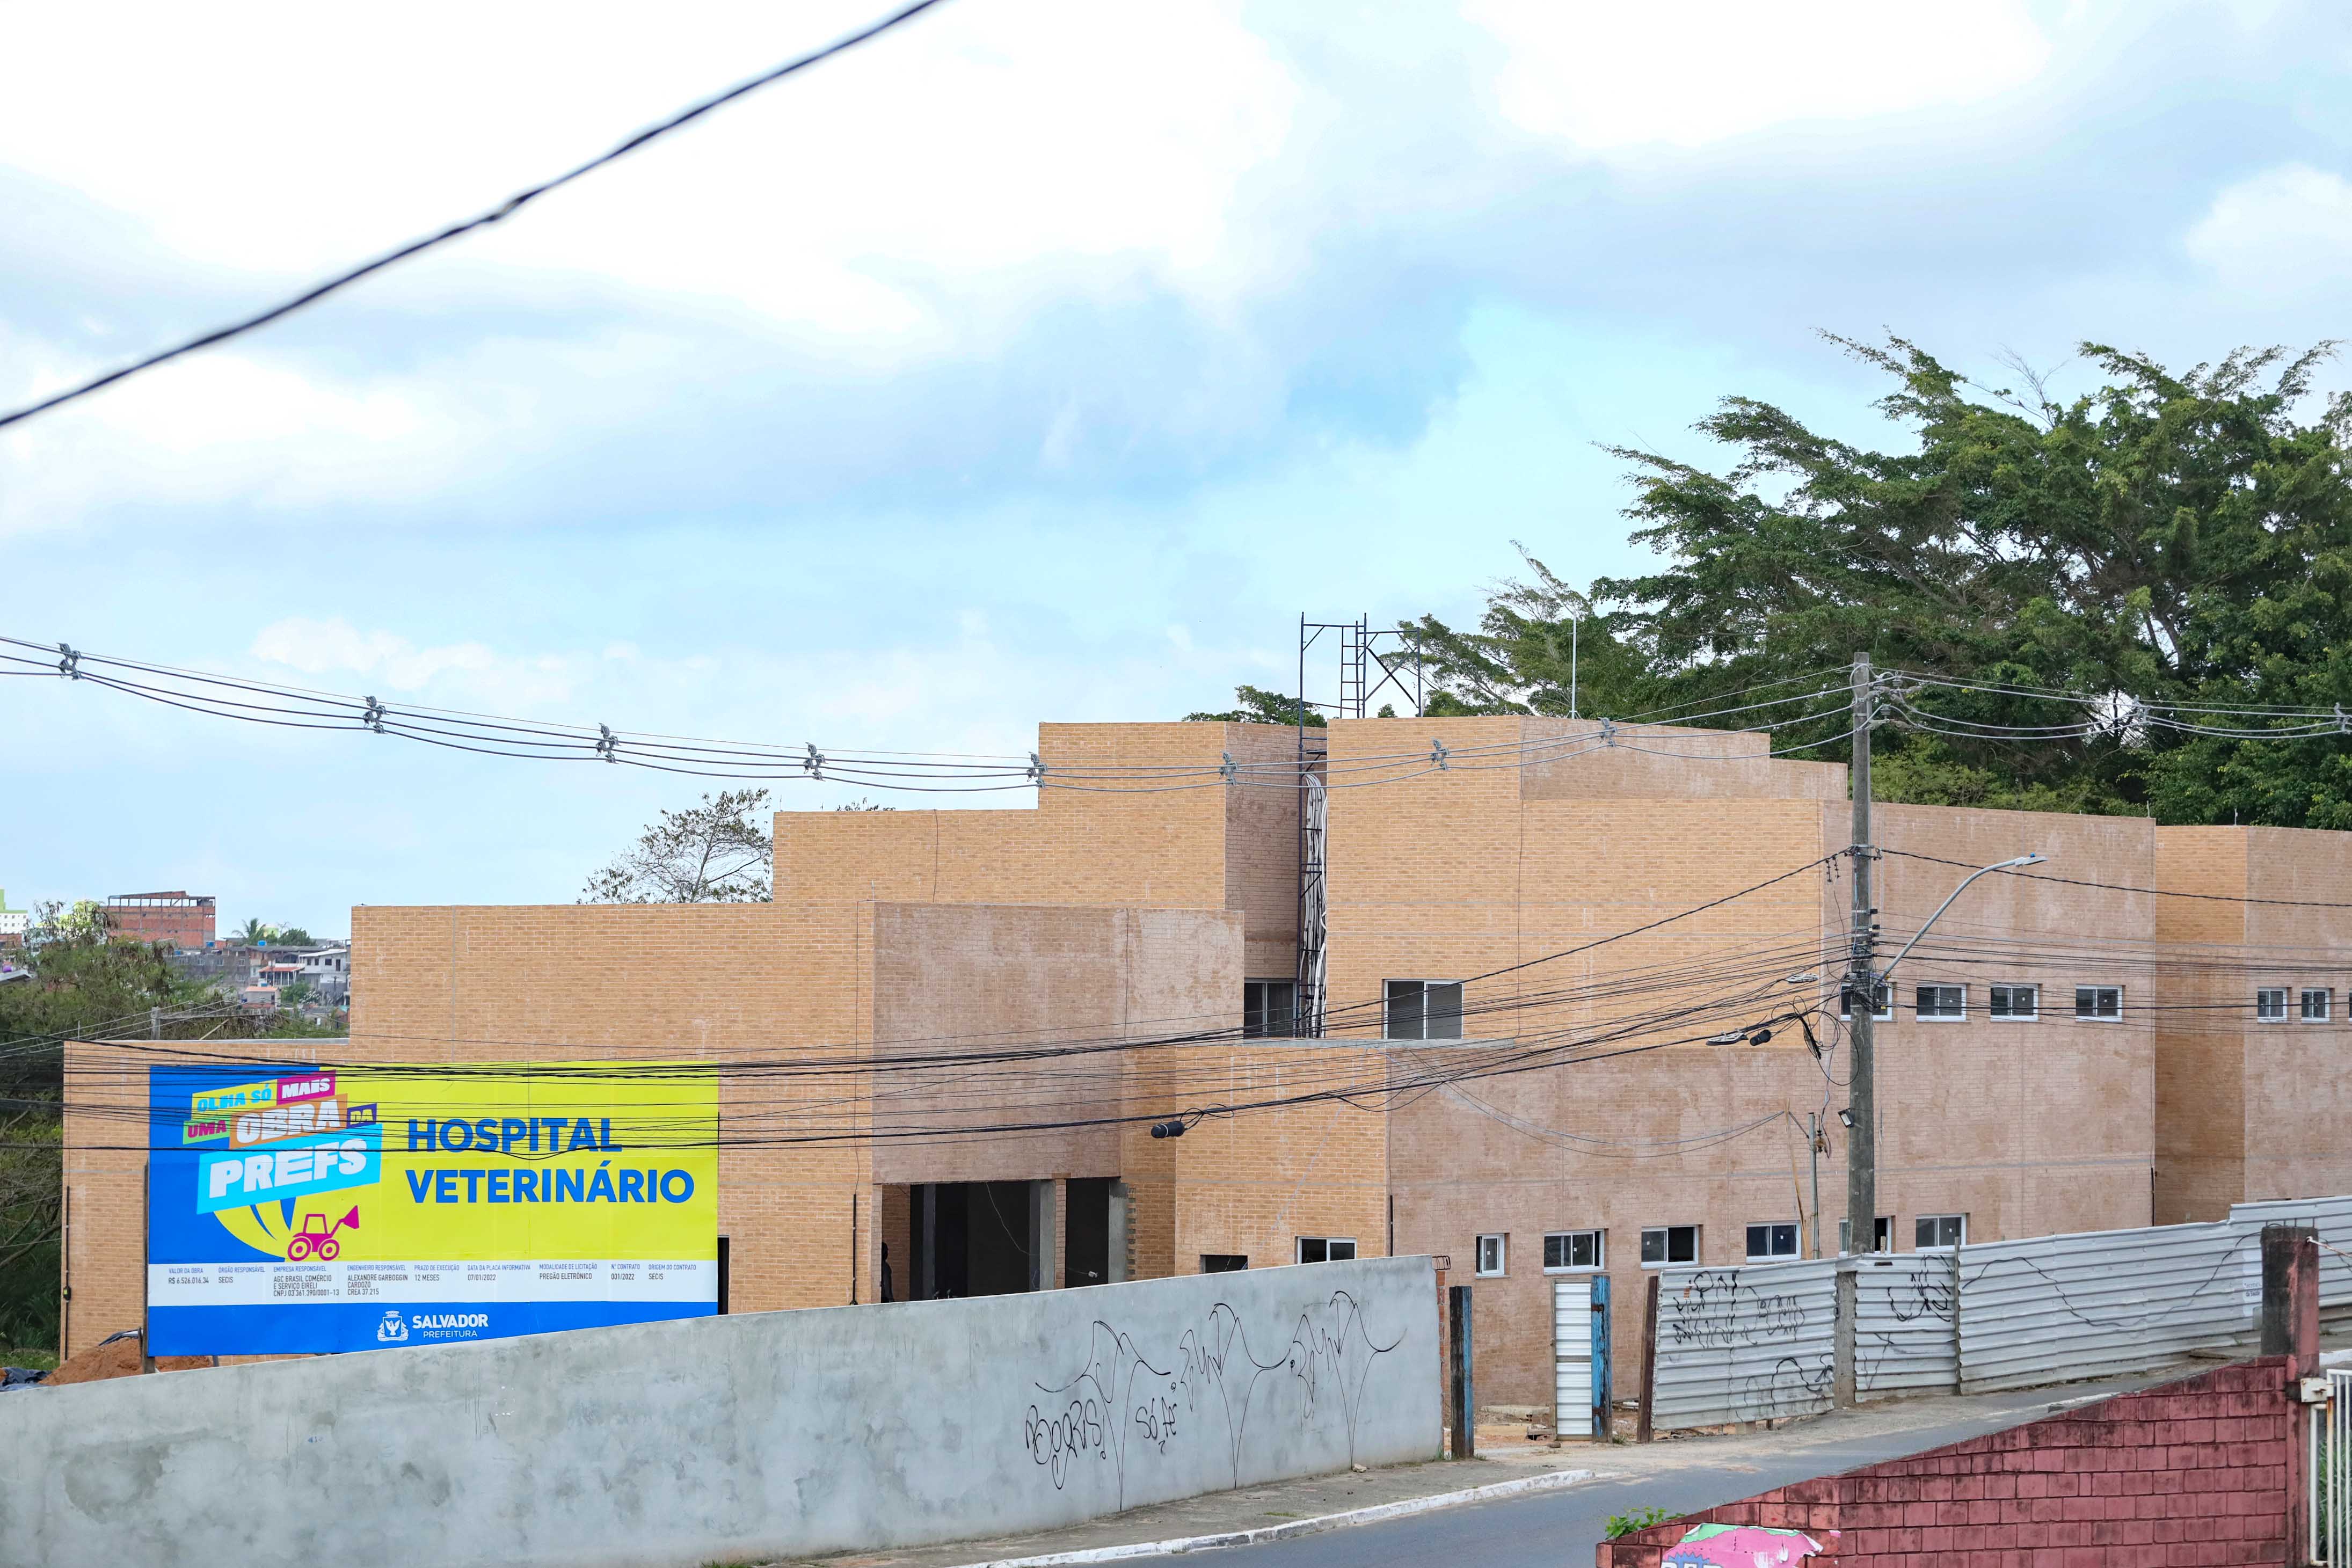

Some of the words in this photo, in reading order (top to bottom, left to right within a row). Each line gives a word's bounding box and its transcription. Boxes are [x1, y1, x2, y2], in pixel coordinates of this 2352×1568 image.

[197, 1092, 246, 1113] OLHA
[251, 1083, 272, 1103] SÓ
[282, 1077, 331, 1099] MAIS
[236, 1099, 341, 1143] OBRA
[350, 1108, 374, 1125] DA
[188, 1119, 227, 1139] UMA
[408, 1118, 622, 1153] HOSPITAL
[209, 1138, 367, 1199] PREFS
[405, 1160, 695, 1204] VETERINÁRIO
[436, 1264, 460, 1272] EXECUÇÃO
[540, 1272, 560, 1280] PREGÃO
[561, 1271, 592, 1279] ELETRÔNICO
[575, 1263, 598, 1271] LICITAÇÃO
[412, 1314, 489, 1329] SALVADOR
[423, 1330, 478, 1338] PREFEITURA
